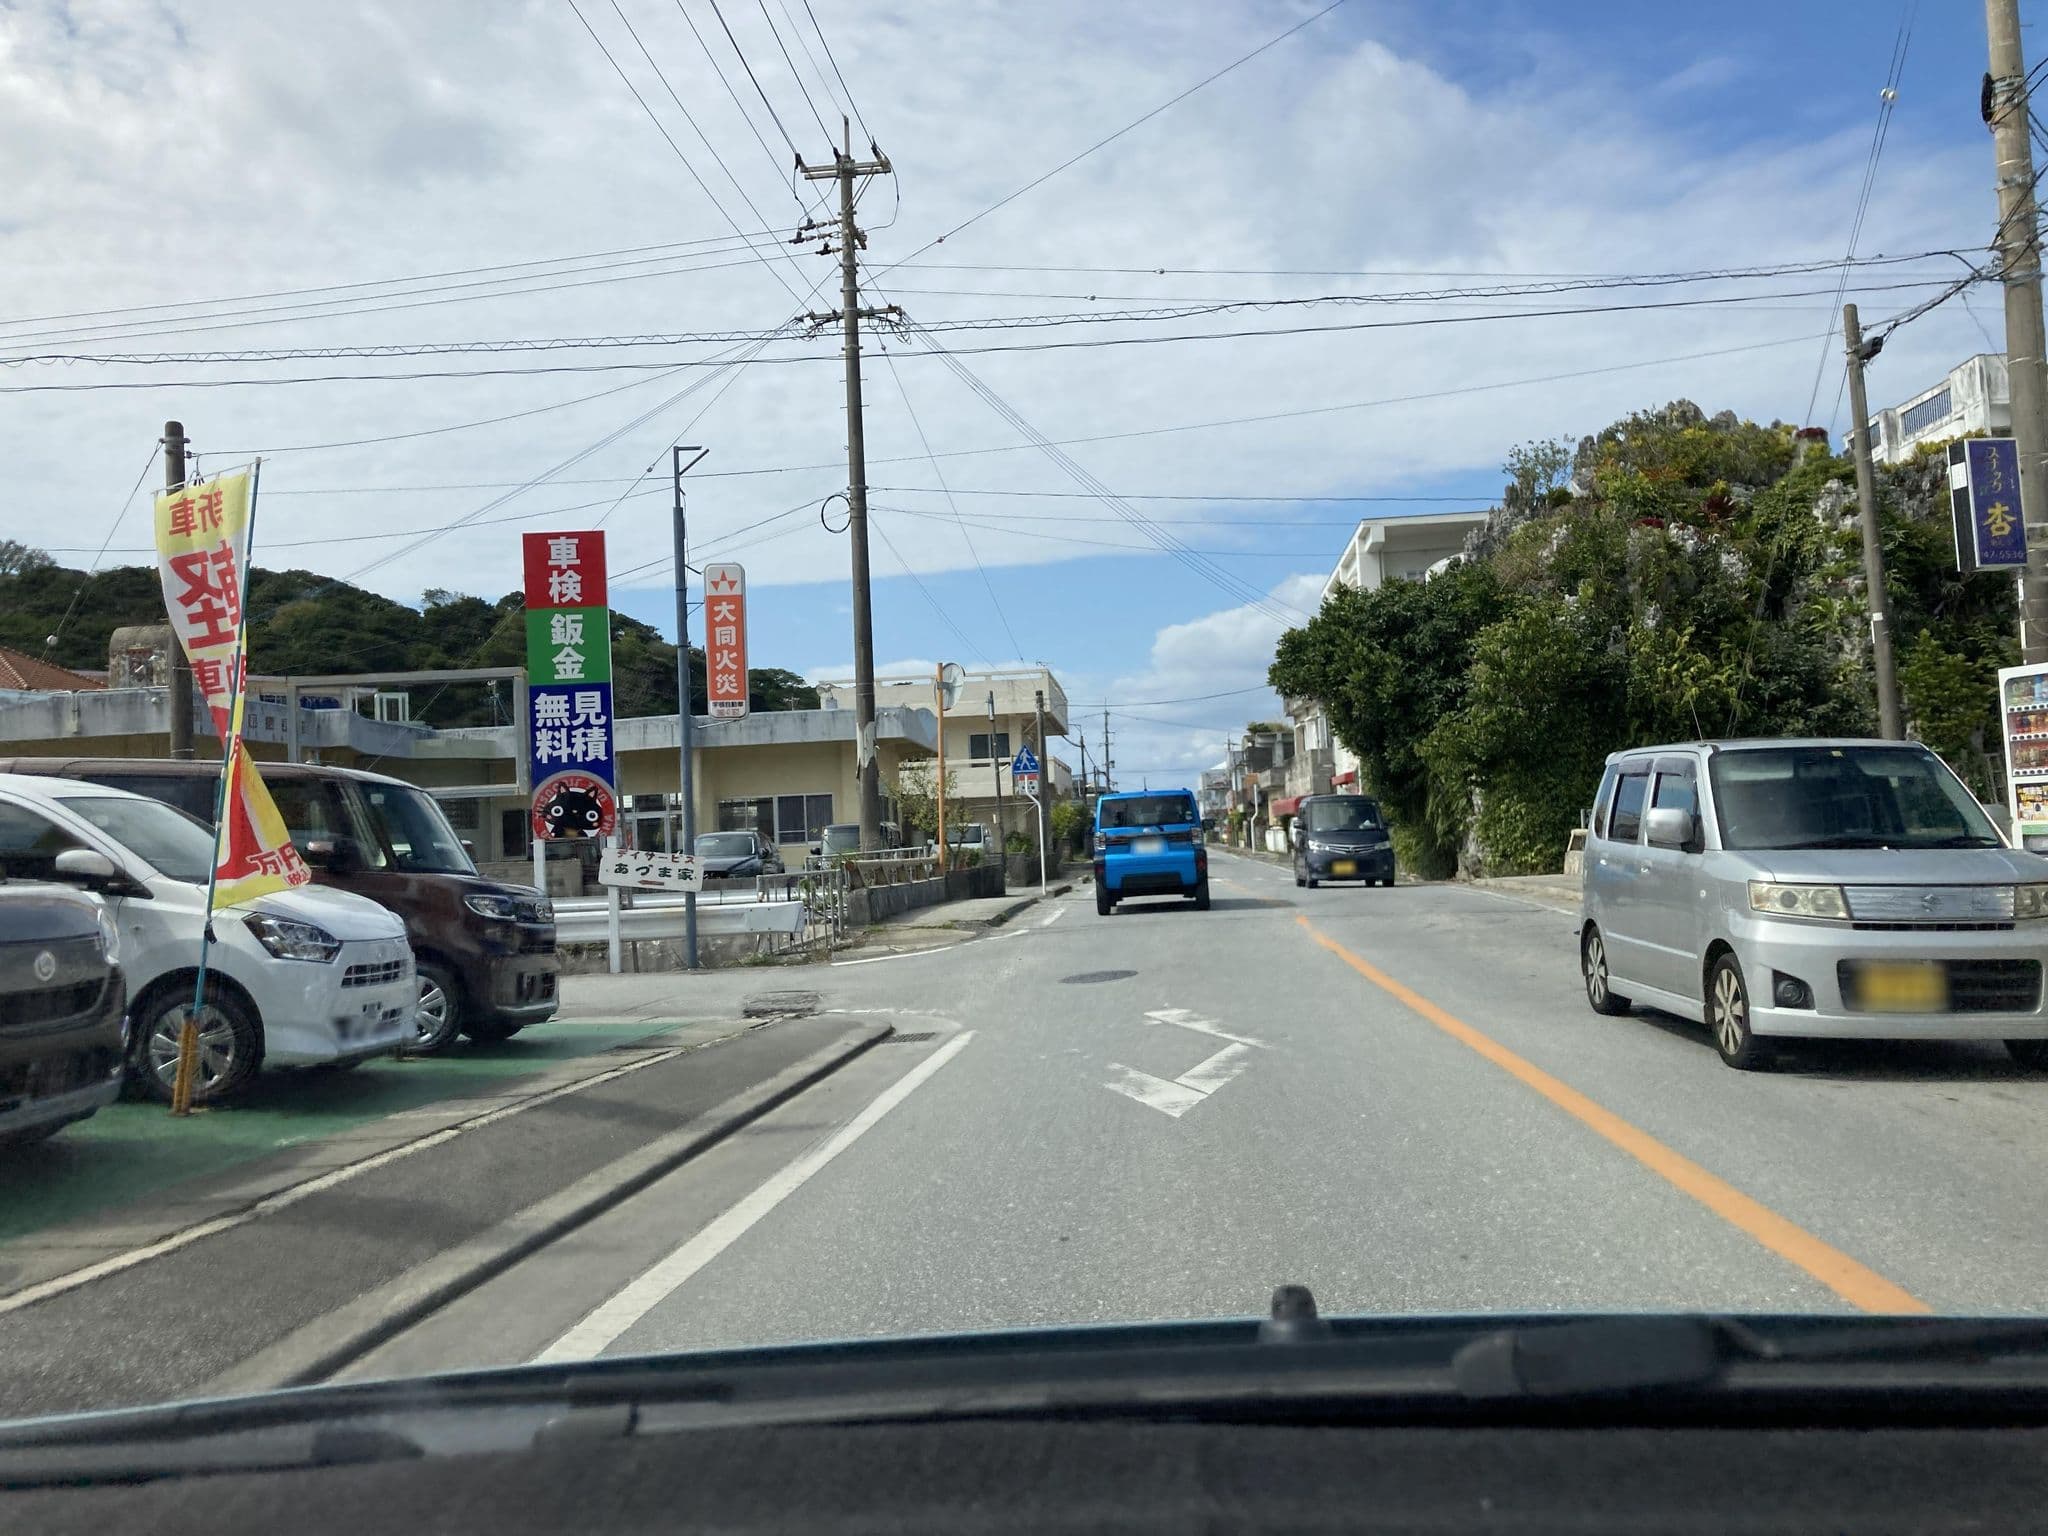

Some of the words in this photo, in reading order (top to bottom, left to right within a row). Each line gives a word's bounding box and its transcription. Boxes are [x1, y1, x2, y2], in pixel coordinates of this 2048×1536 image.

[1985, 446, 2004, 494] スナック
[1983, 501, 2018, 537] 杏
[547, 535, 583, 605] 車検
[550, 612, 586, 681] 鈑金
[712, 600, 740, 697] 大同火災
[534, 692, 571, 765] 無料
[570, 691, 609, 763] 見積
[614, 862, 695, 881] あづま家
[616, 848, 696, 865] デイサービス
